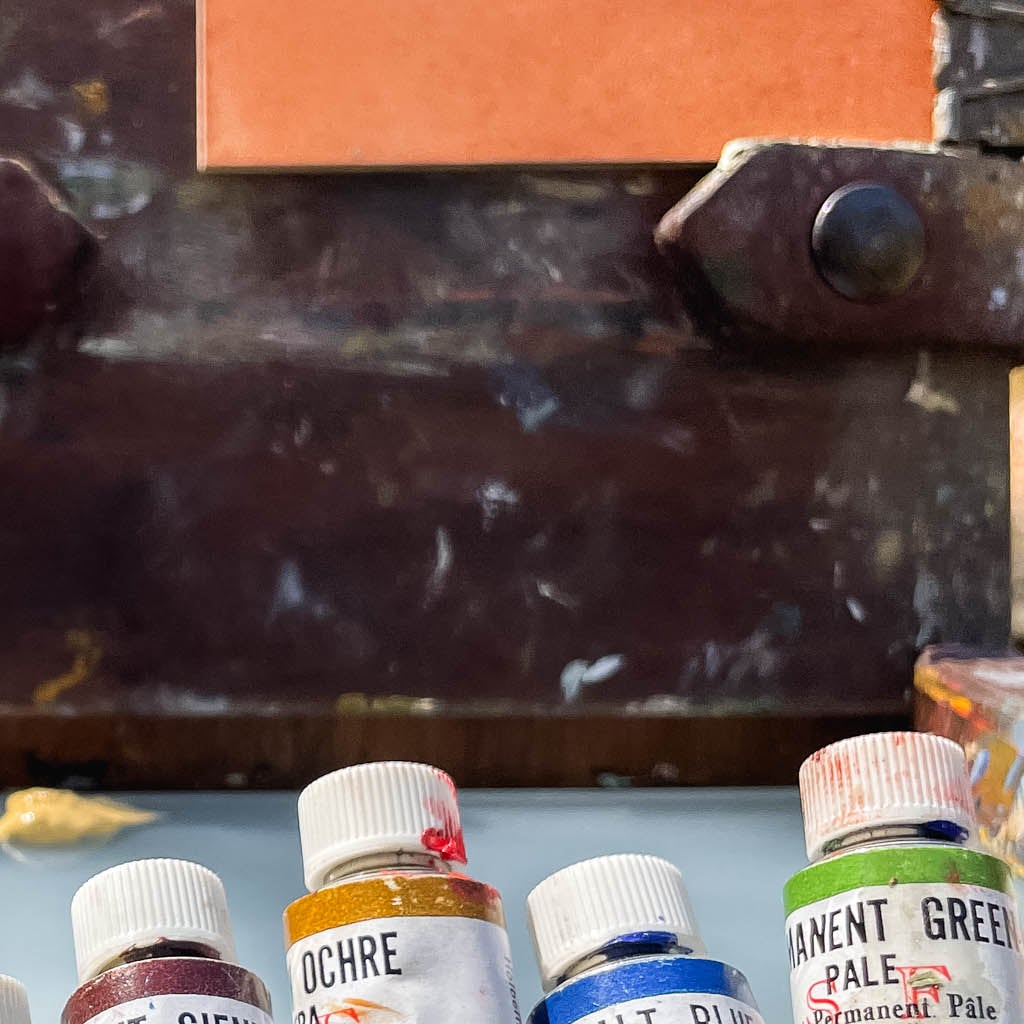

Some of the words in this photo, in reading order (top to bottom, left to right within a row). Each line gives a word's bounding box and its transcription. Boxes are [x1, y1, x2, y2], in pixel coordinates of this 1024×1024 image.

[302, 931, 403, 994] OCHRE
[826, 954, 900, 995] PALE
[947, 993, 998, 1020] Pâle
